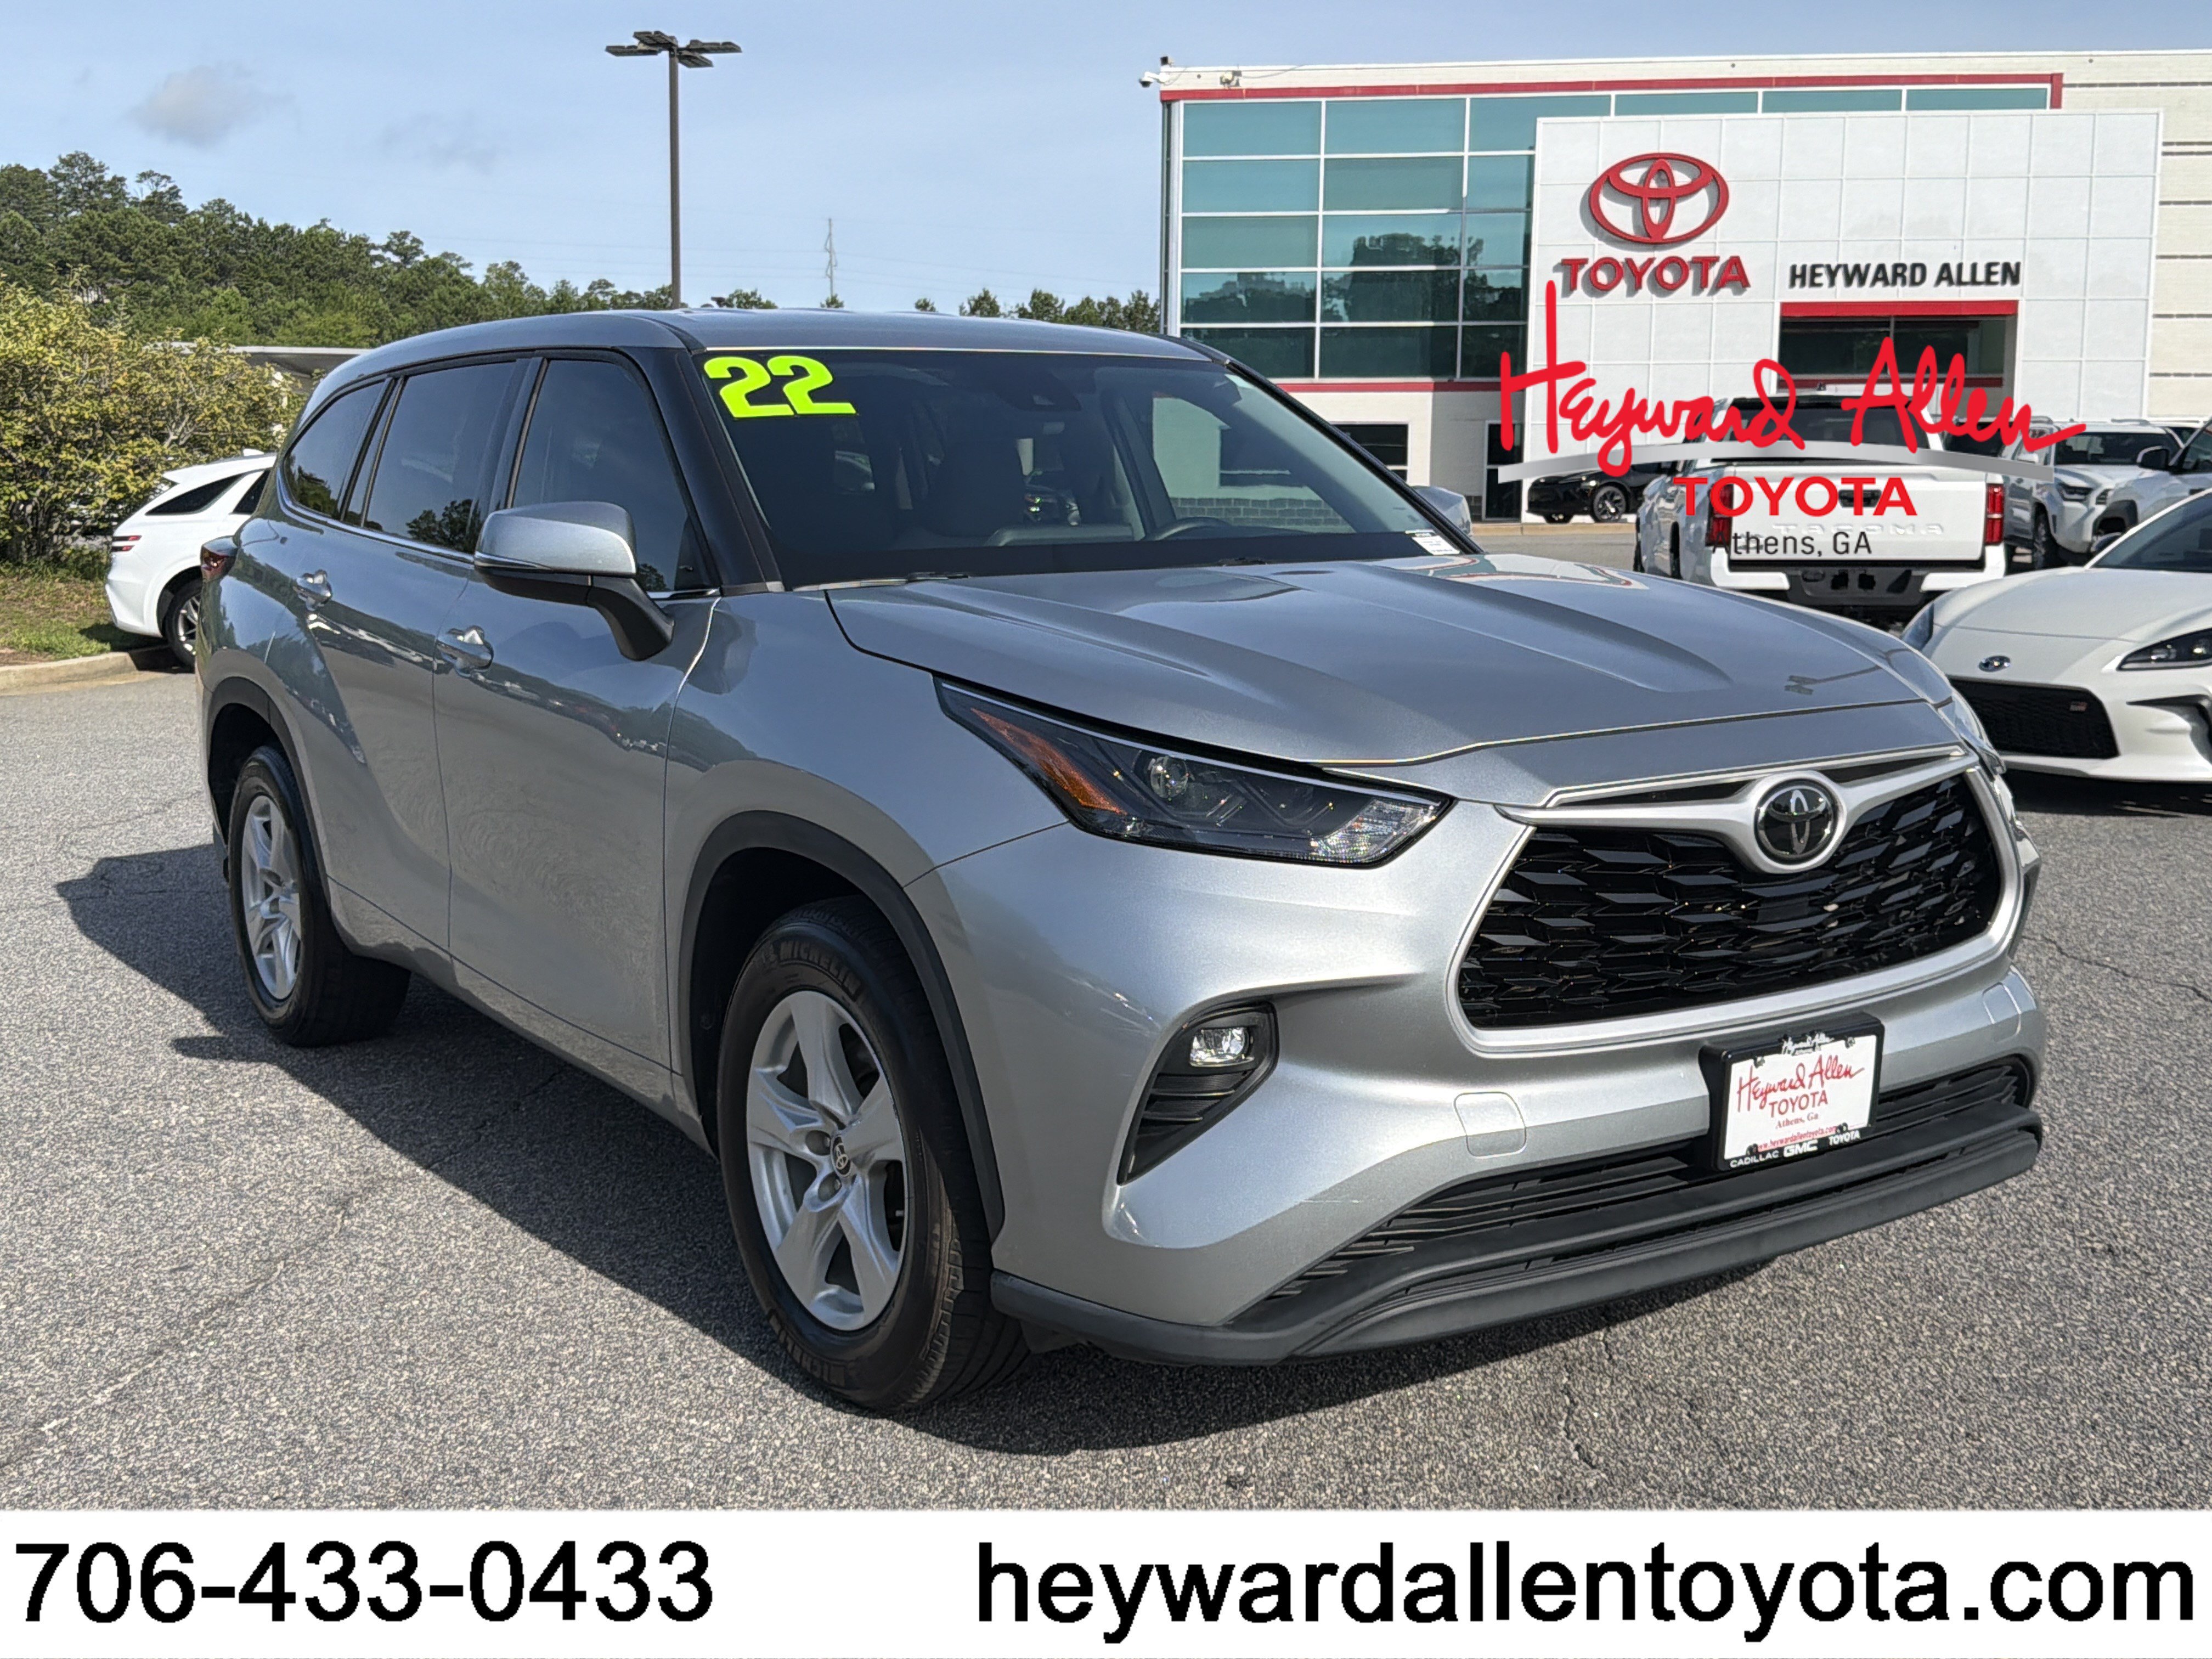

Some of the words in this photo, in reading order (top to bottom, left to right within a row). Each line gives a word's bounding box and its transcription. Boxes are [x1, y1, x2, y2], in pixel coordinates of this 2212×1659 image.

[1561, 256, 1750, 290] TOYOTA
[1790, 263, 1927, 287] HEYWARD
[1935, 262, 2021, 286] ALLEN
[704, 356, 857, 417] 22
[1736, 1063, 1806, 1113] Heyward
[1808, 1054, 1865, 1089] Allen
[1769, 1090, 1829, 1118] TOYOTA
[1807, 1111, 1819, 1121] Ga
[1729, 1150, 1780, 1168] CADILLAC
[1783, 1139, 1818, 1158] GMC
[1828, 1130, 1861, 1146] TOYOTA
